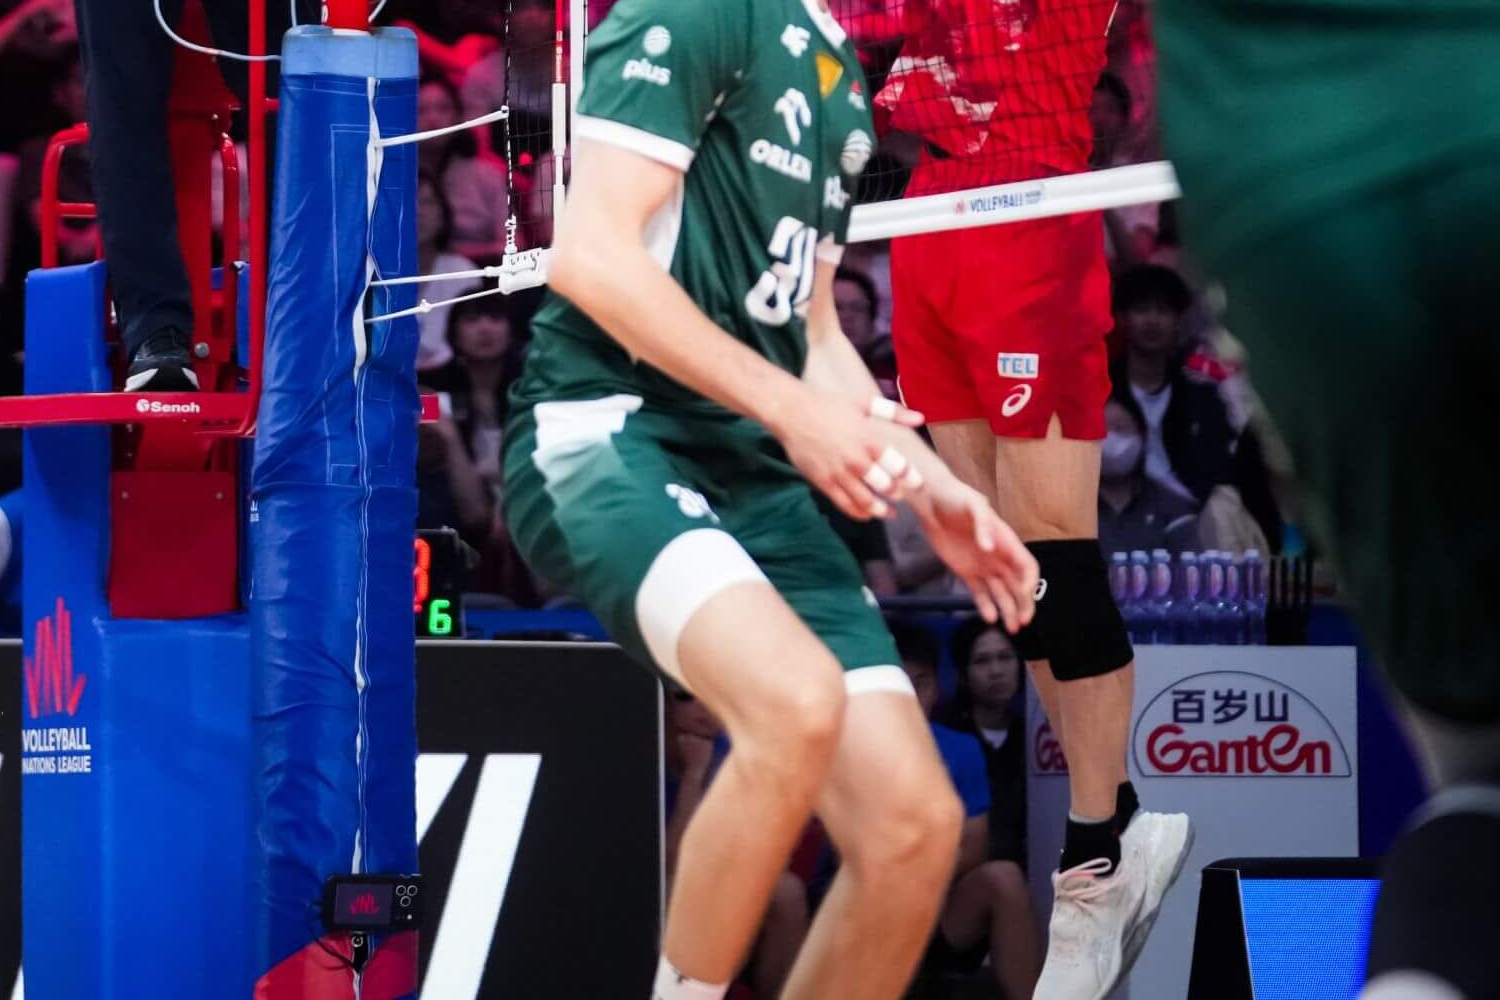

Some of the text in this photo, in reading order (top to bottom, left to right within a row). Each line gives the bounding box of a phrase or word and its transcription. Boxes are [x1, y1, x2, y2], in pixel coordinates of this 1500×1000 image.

[622, 58, 671, 86] plus
[151, 400, 200, 413] Senoh
[428, 599, 453, 634] 6
[1172, 689, 1289, 724] 百岁山
[22, 727, 92, 753] VOLLEYBALL
[22, 755, 92, 775] NATIONS LEAGUE
